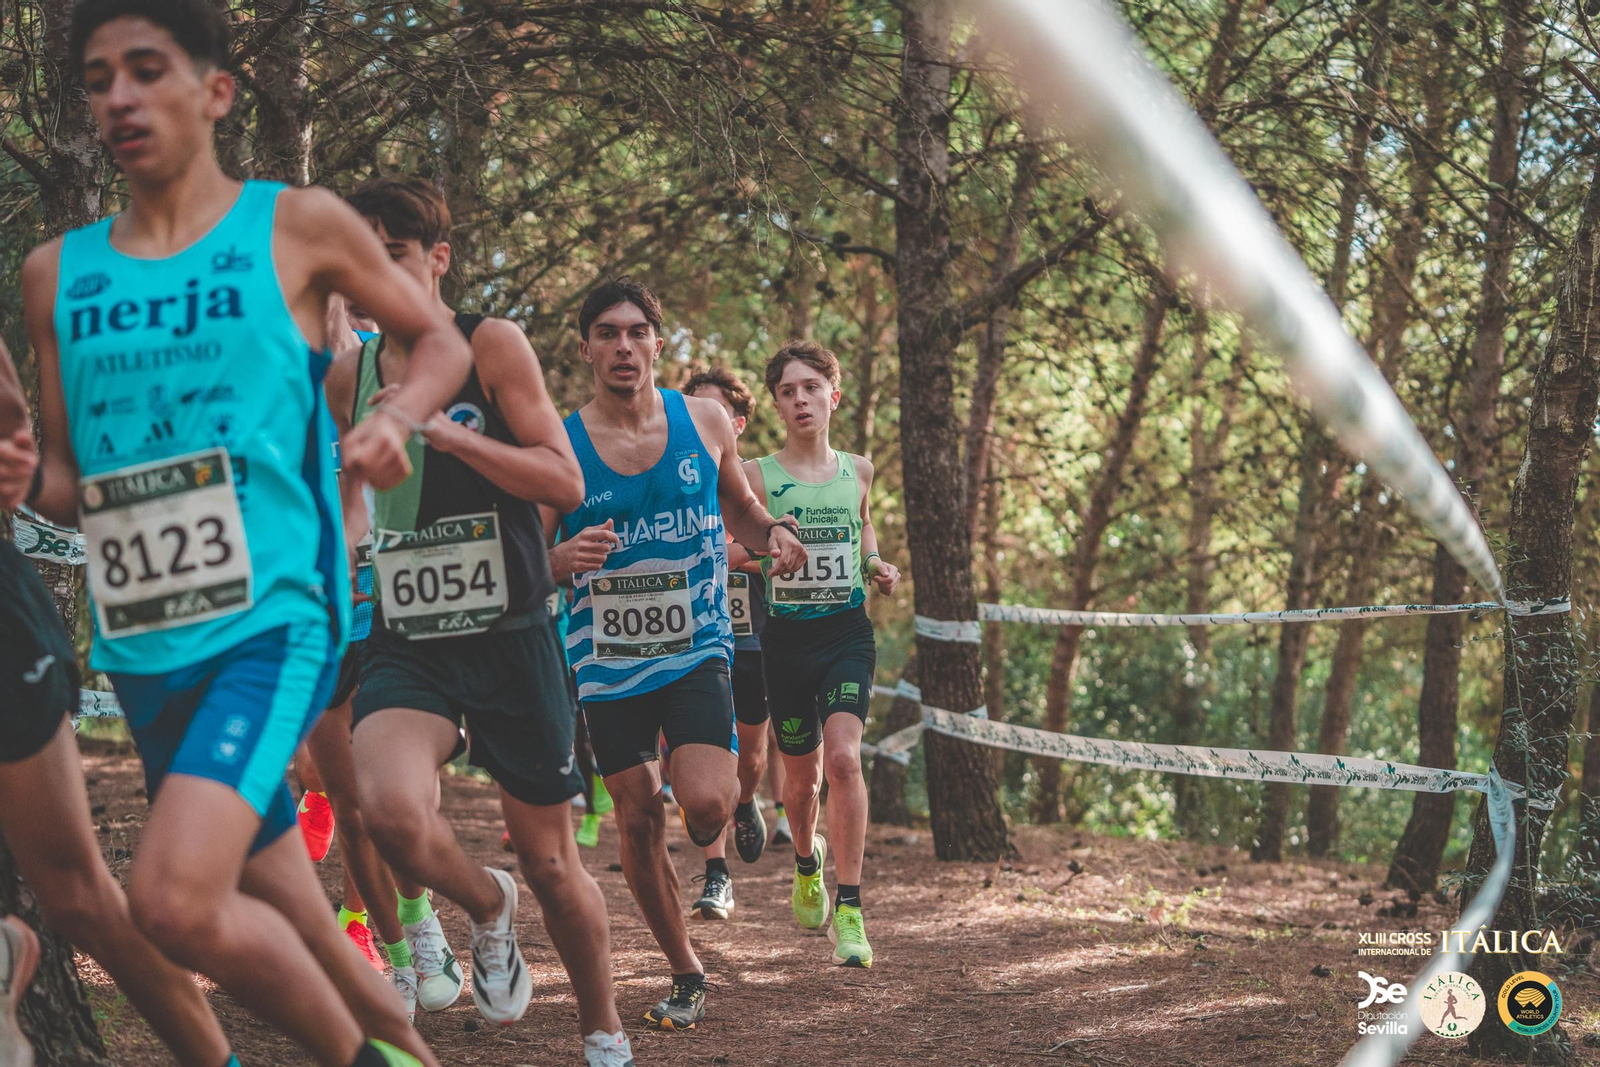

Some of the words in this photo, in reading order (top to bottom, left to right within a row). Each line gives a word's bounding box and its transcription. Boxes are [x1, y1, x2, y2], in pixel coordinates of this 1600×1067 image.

[70, 278, 245, 344] nerja
[95, 340, 222, 374] ATLETISMO
[583, 490, 613, 508] vive
[805, 506, 849, 516] Fundación
[612, 504, 704, 549] HAPIN
[805, 514, 838, 525] Unicaja
[102, 516, 232, 588] 8123
[392, 559, 497, 607] 6054
[617, 576, 663, 589] ITÁLICA
[602, 604, 686, 637] 8080
